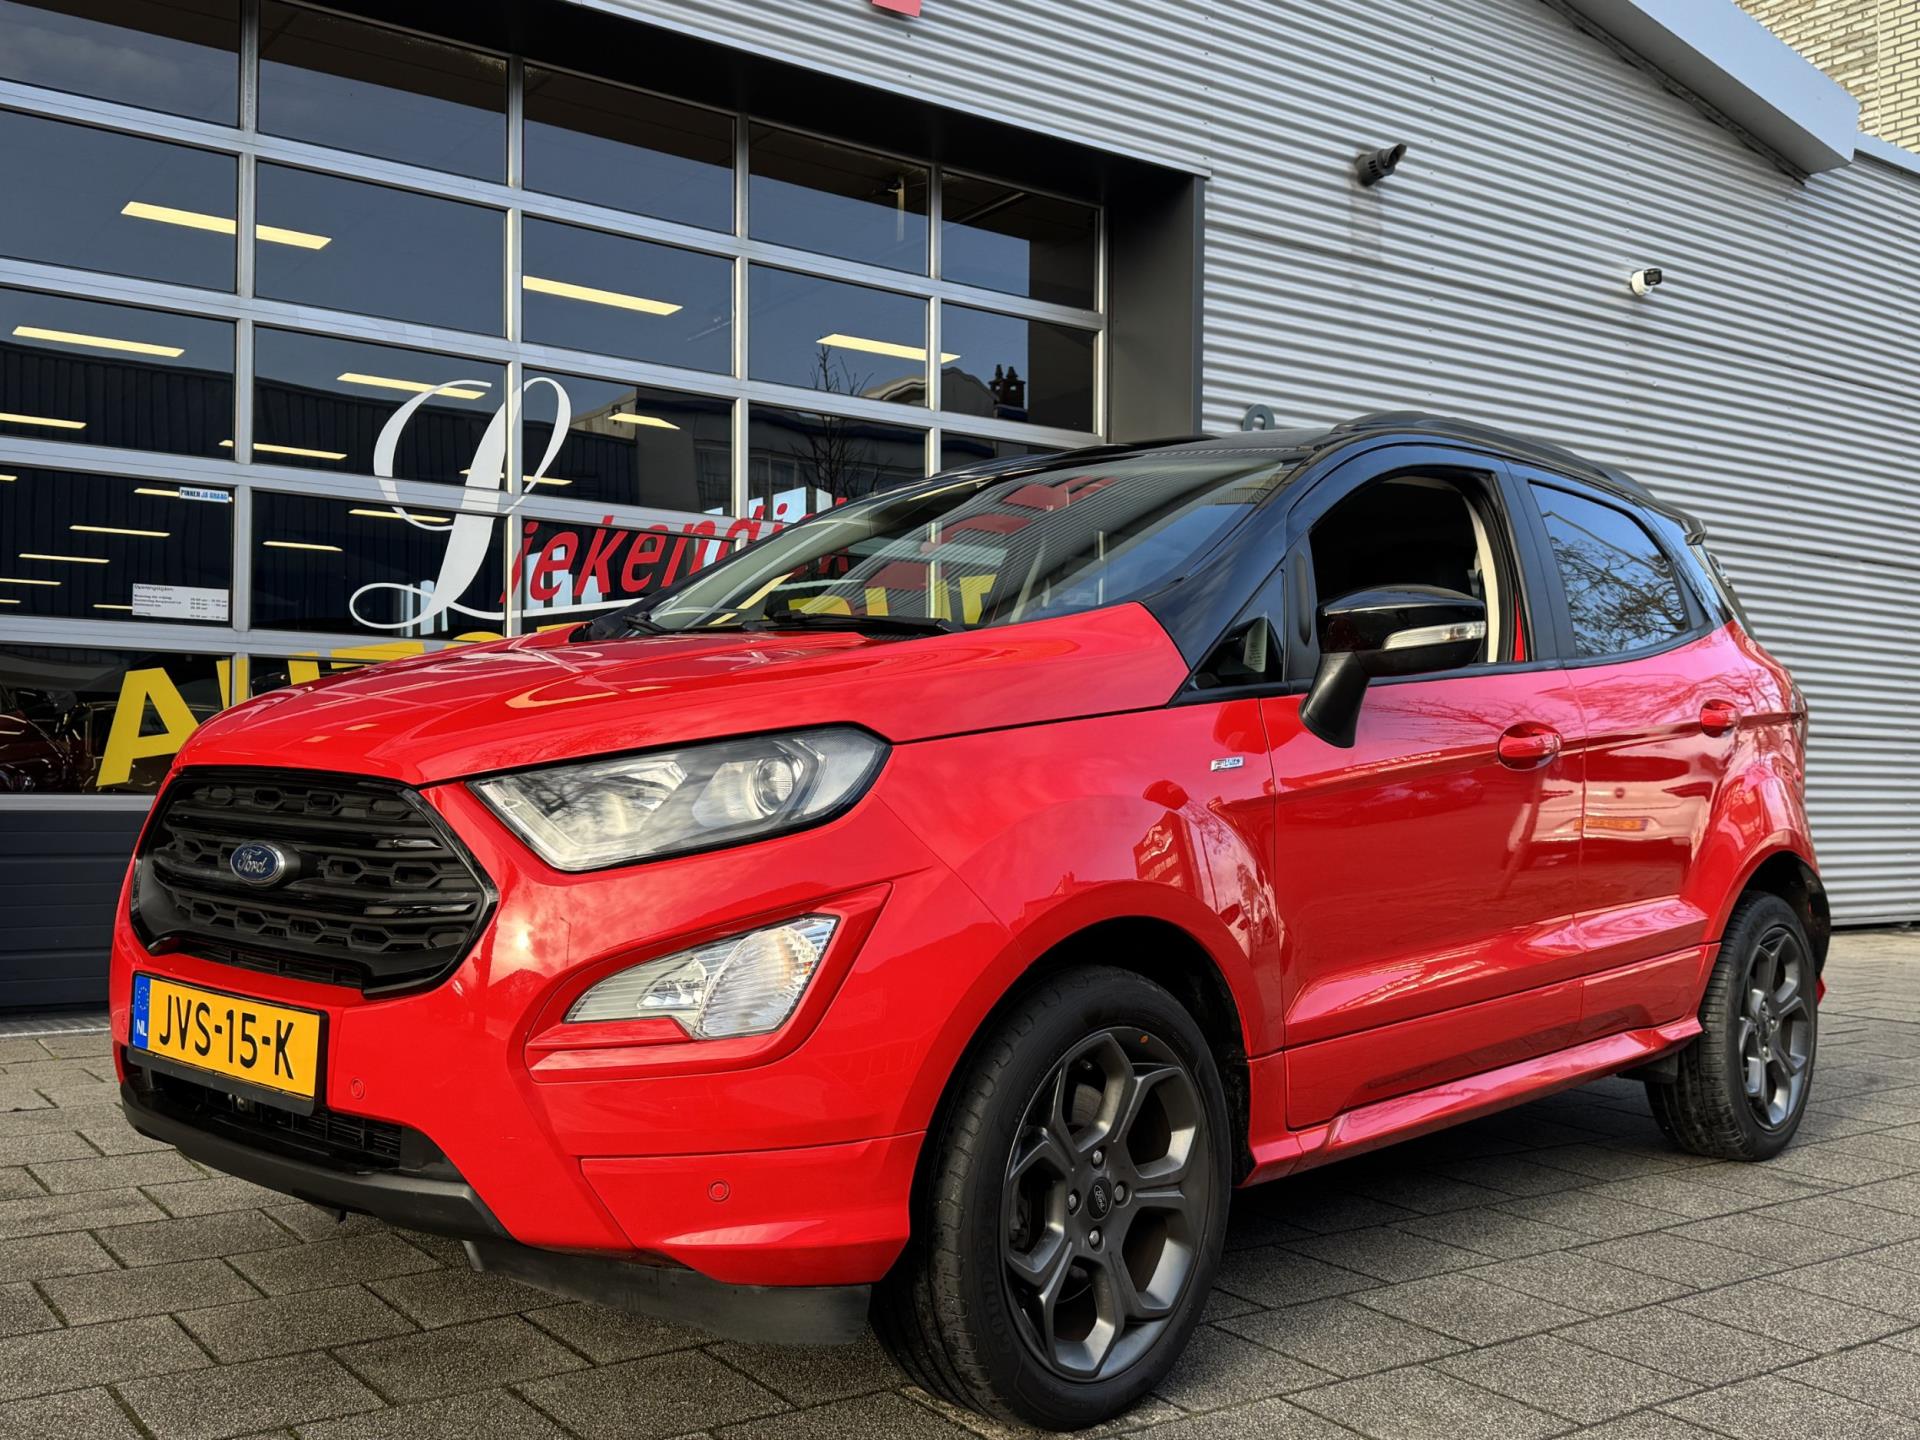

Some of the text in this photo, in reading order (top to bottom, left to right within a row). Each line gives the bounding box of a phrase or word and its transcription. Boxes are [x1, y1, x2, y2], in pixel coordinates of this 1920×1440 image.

[237, 848, 268, 874] Ford
[136, 1018, 147, 1037] NL
[159, 994, 294, 1080] JVS-15-K
